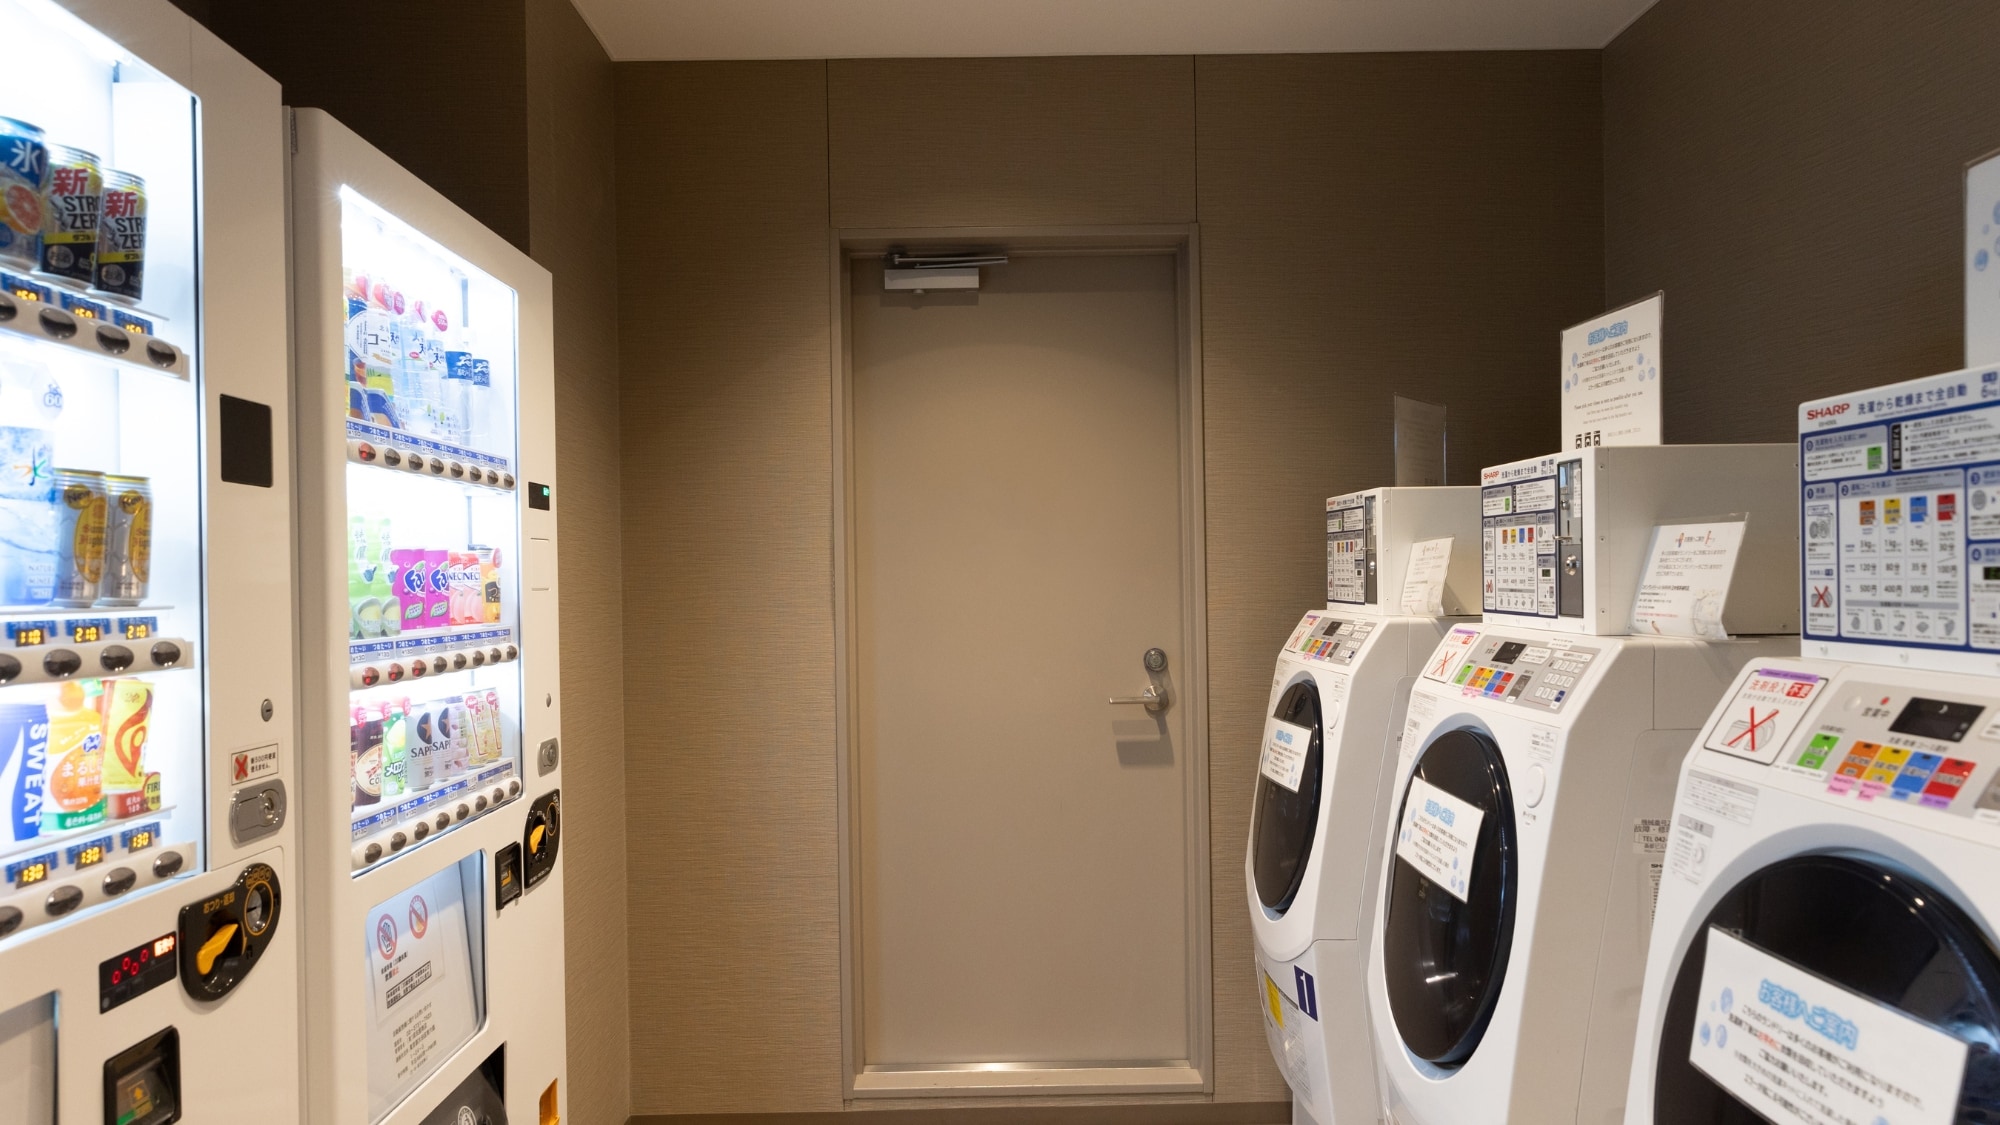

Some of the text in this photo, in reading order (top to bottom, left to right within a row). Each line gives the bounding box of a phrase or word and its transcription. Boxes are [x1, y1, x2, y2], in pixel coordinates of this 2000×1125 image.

[11, 140, 40, 173] 氷
[52, 168, 88, 197] 新
[104, 191, 137, 219] 新
[1858, 384, 1967, 415] 洗濯から乾燥まで全自動
[1807, 403, 1850, 420] SHARP
[1484, 470, 1500, 480] SHARP
[20, 629, 41, 645] 110
[75, 627, 97, 643] 210
[127, 624, 147, 639] 210
[23, 723, 47, 826] SWEAT
[133, 832, 149, 848] 130
[81, 847, 100, 864] 130
[23, 864, 44, 882] 130
[1300, 972, 1311, 1014] 1
